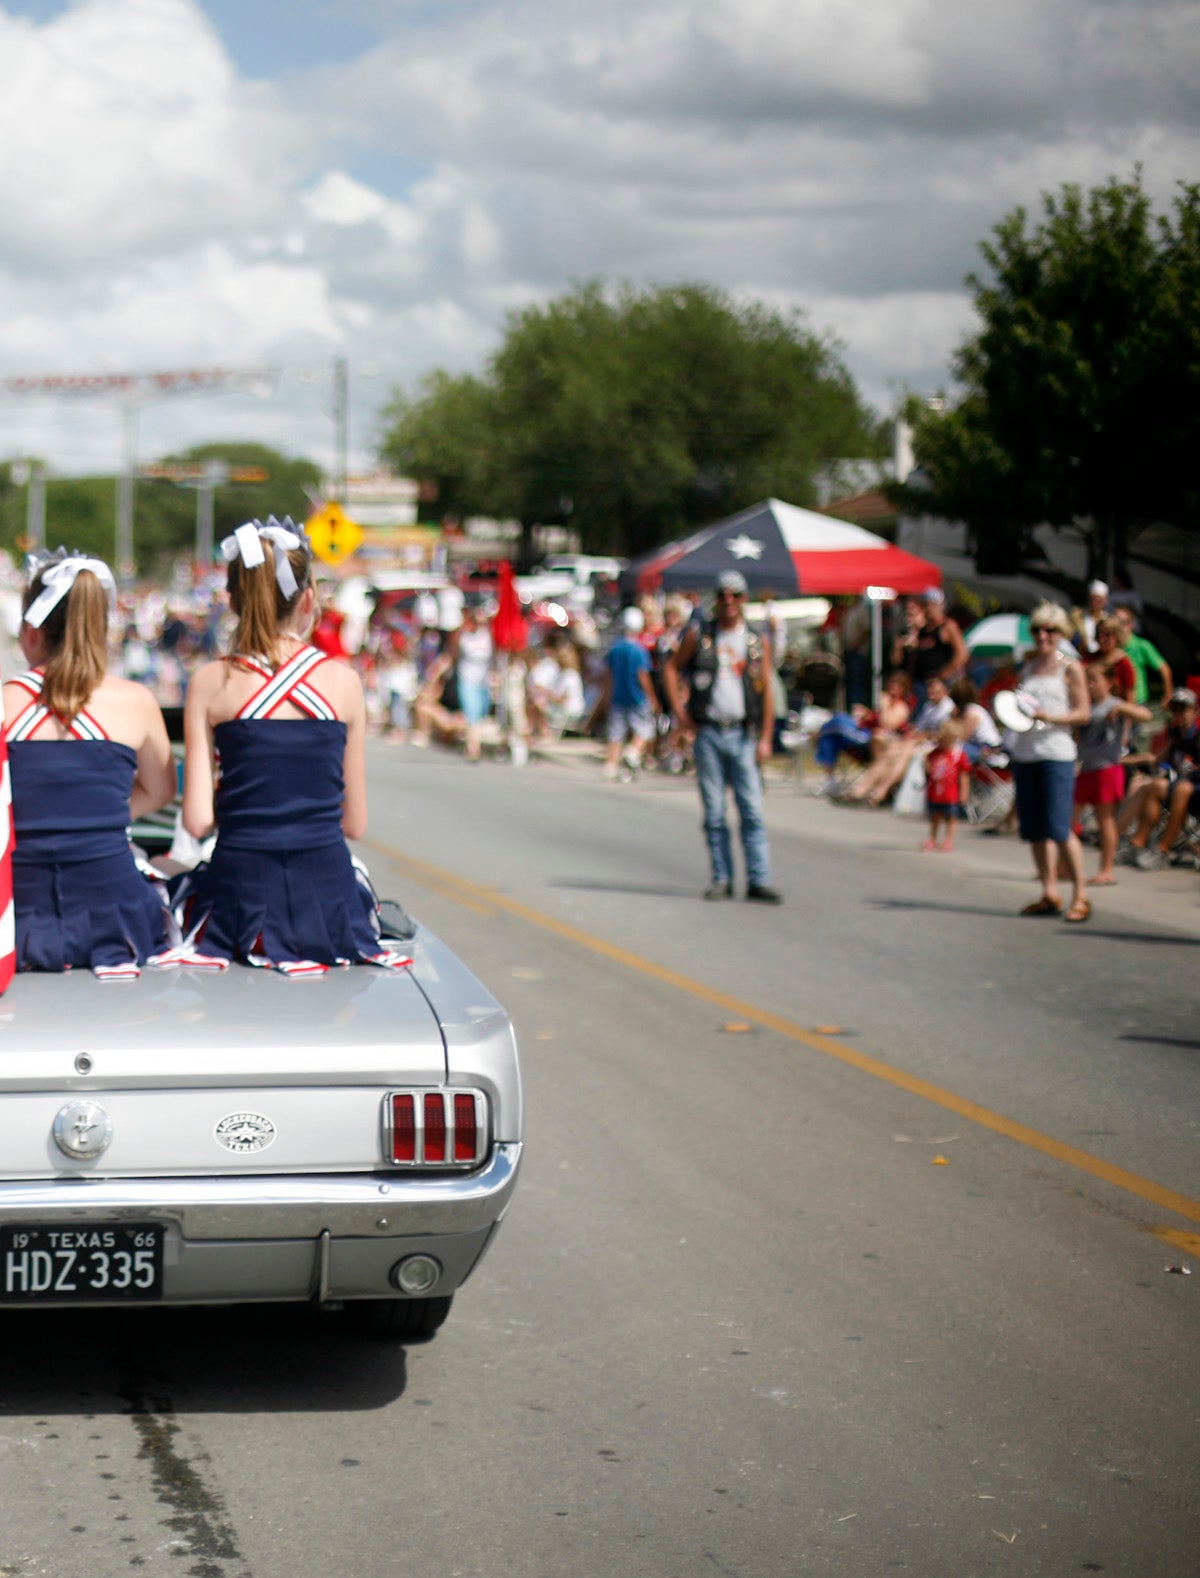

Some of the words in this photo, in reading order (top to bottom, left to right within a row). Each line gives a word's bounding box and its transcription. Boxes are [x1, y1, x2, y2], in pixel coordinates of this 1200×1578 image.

[228, 1141, 263, 1152] TEXAS
[13, 1233, 29, 1248] 19
[48, 1232, 115, 1248] TEXAS
[134, 1232, 155, 1247] 66
